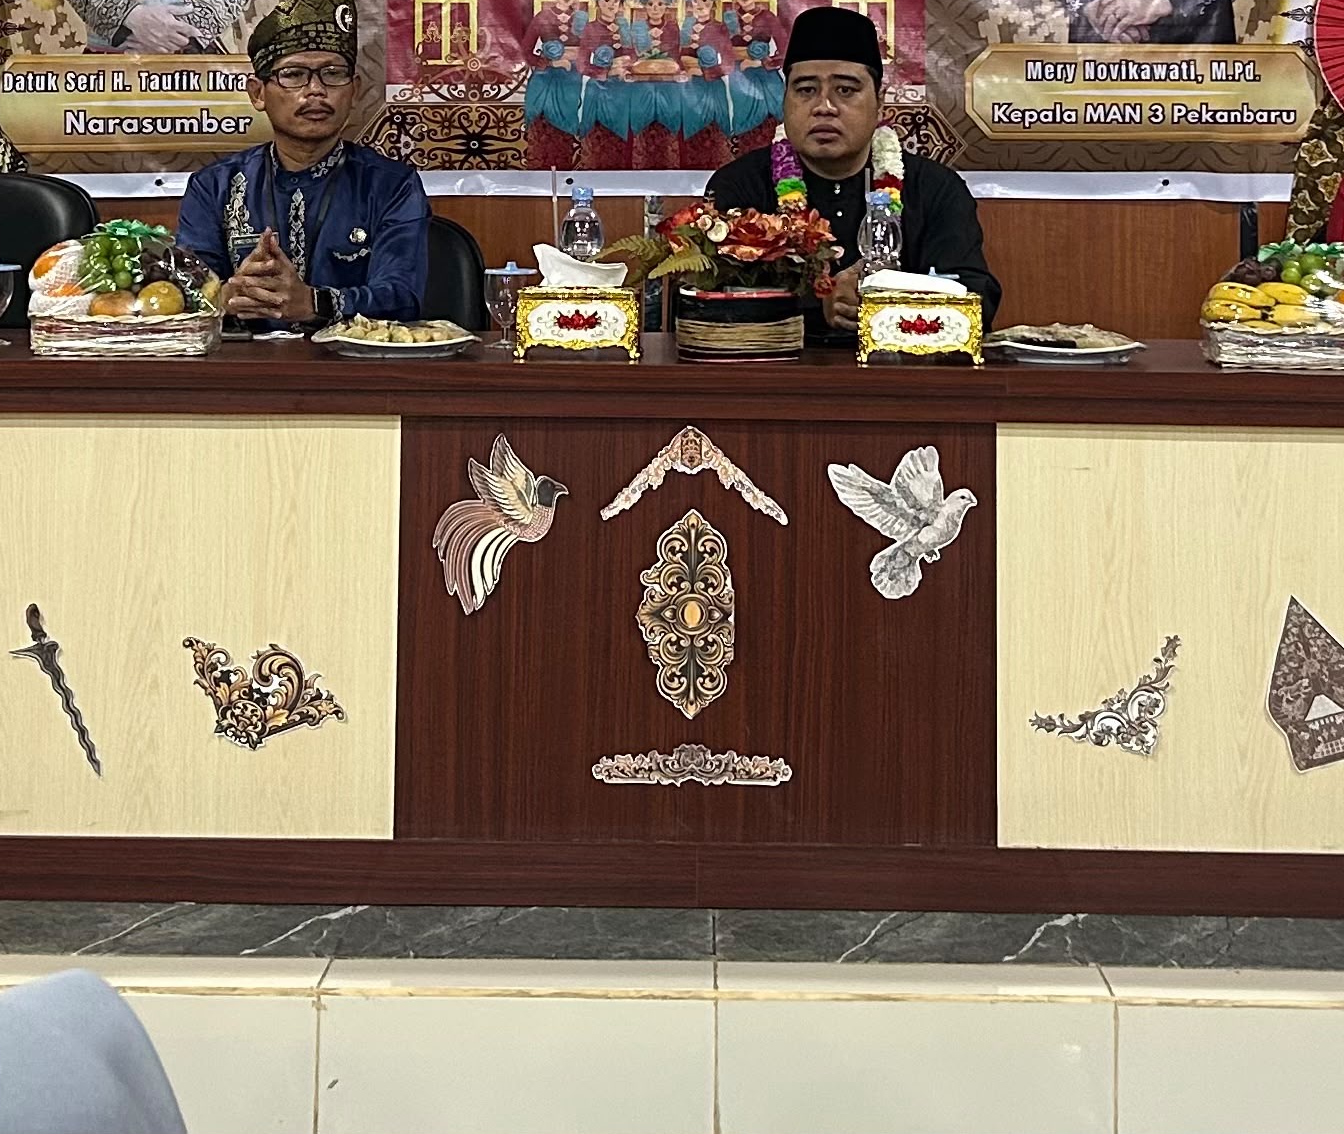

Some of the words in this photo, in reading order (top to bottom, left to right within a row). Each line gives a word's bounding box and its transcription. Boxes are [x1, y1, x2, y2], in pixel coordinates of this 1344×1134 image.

[2, 71, 59, 93] Datuk
[66, 71, 105, 92] Seri
[112, 71, 132, 92] H.
[139, 71, 202, 92] Taufik
[208, 71, 255, 92] Ikra
[1025, 60, 1076, 84] Mery
[1084, 59, 1204, 85] Novikawati,
[1210, 61, 1262, 83] M.Pd.
[64, 108, 252, 136] Narasumber
[992, 103, 1078, 130] Kepala
[1084, 104, 1142, 125] MAN
[1148, 104, 1165, 125] 3
[1172, 103, 1298, 126] Pekanbaru
